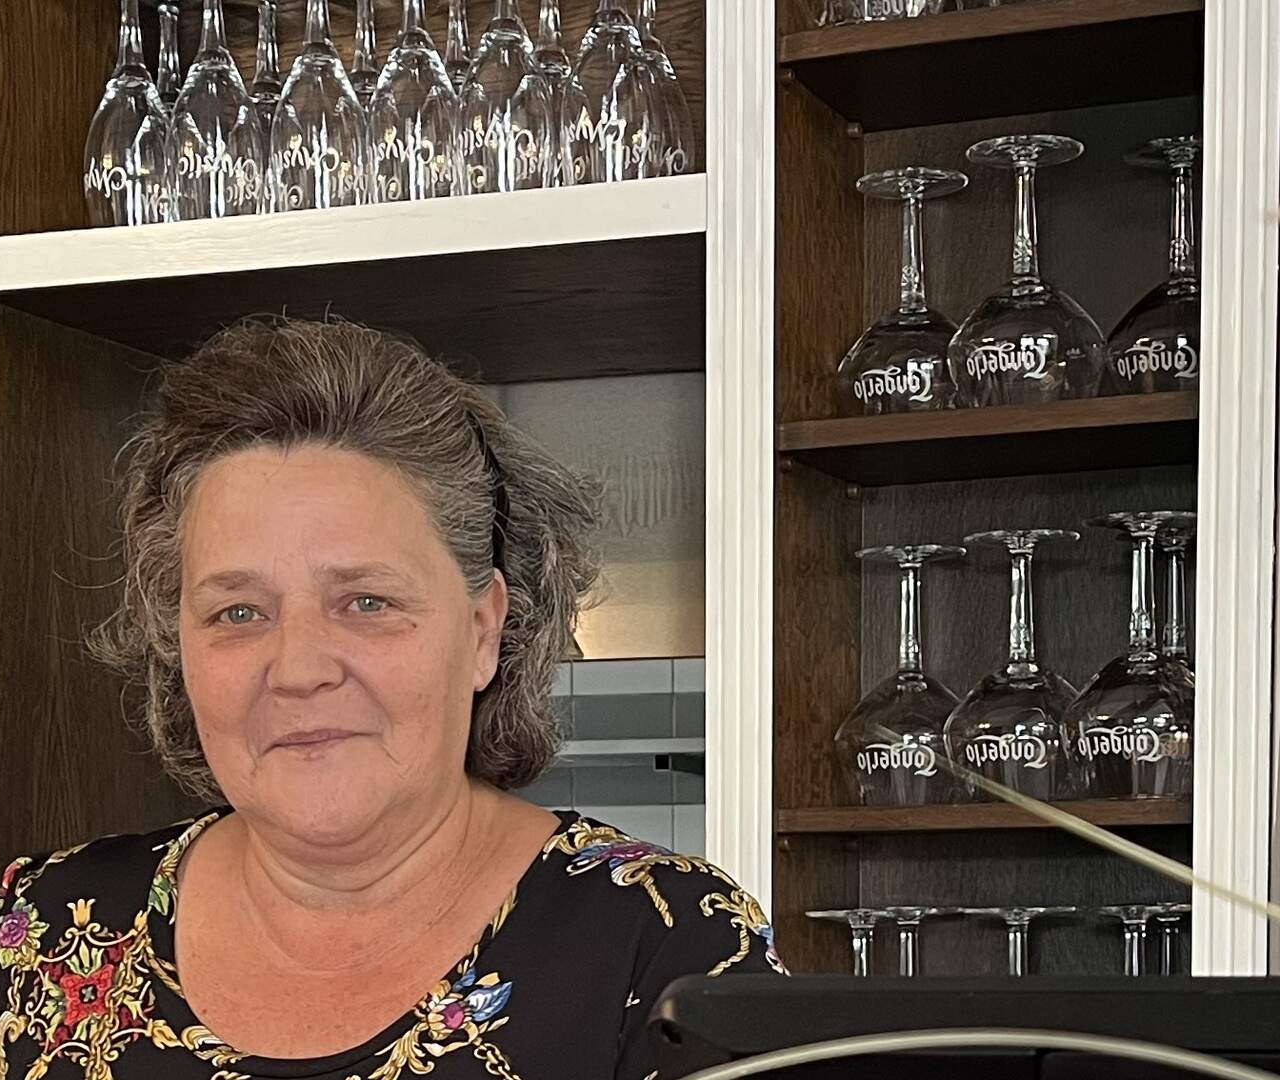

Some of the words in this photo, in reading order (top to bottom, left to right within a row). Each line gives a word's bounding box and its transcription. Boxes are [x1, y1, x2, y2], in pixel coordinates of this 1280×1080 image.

[966, 343, 1051, 381] Tongerlo
[1117, 344, 1197, 381] Tongerlo
[854, 366, 933, 402] Tongerlo
[857, 743, 938, 777] Tongerlo
[966, 734, 1048, 769] Tongerlo
[1078, 726, 1163, 763] Tongerlo
